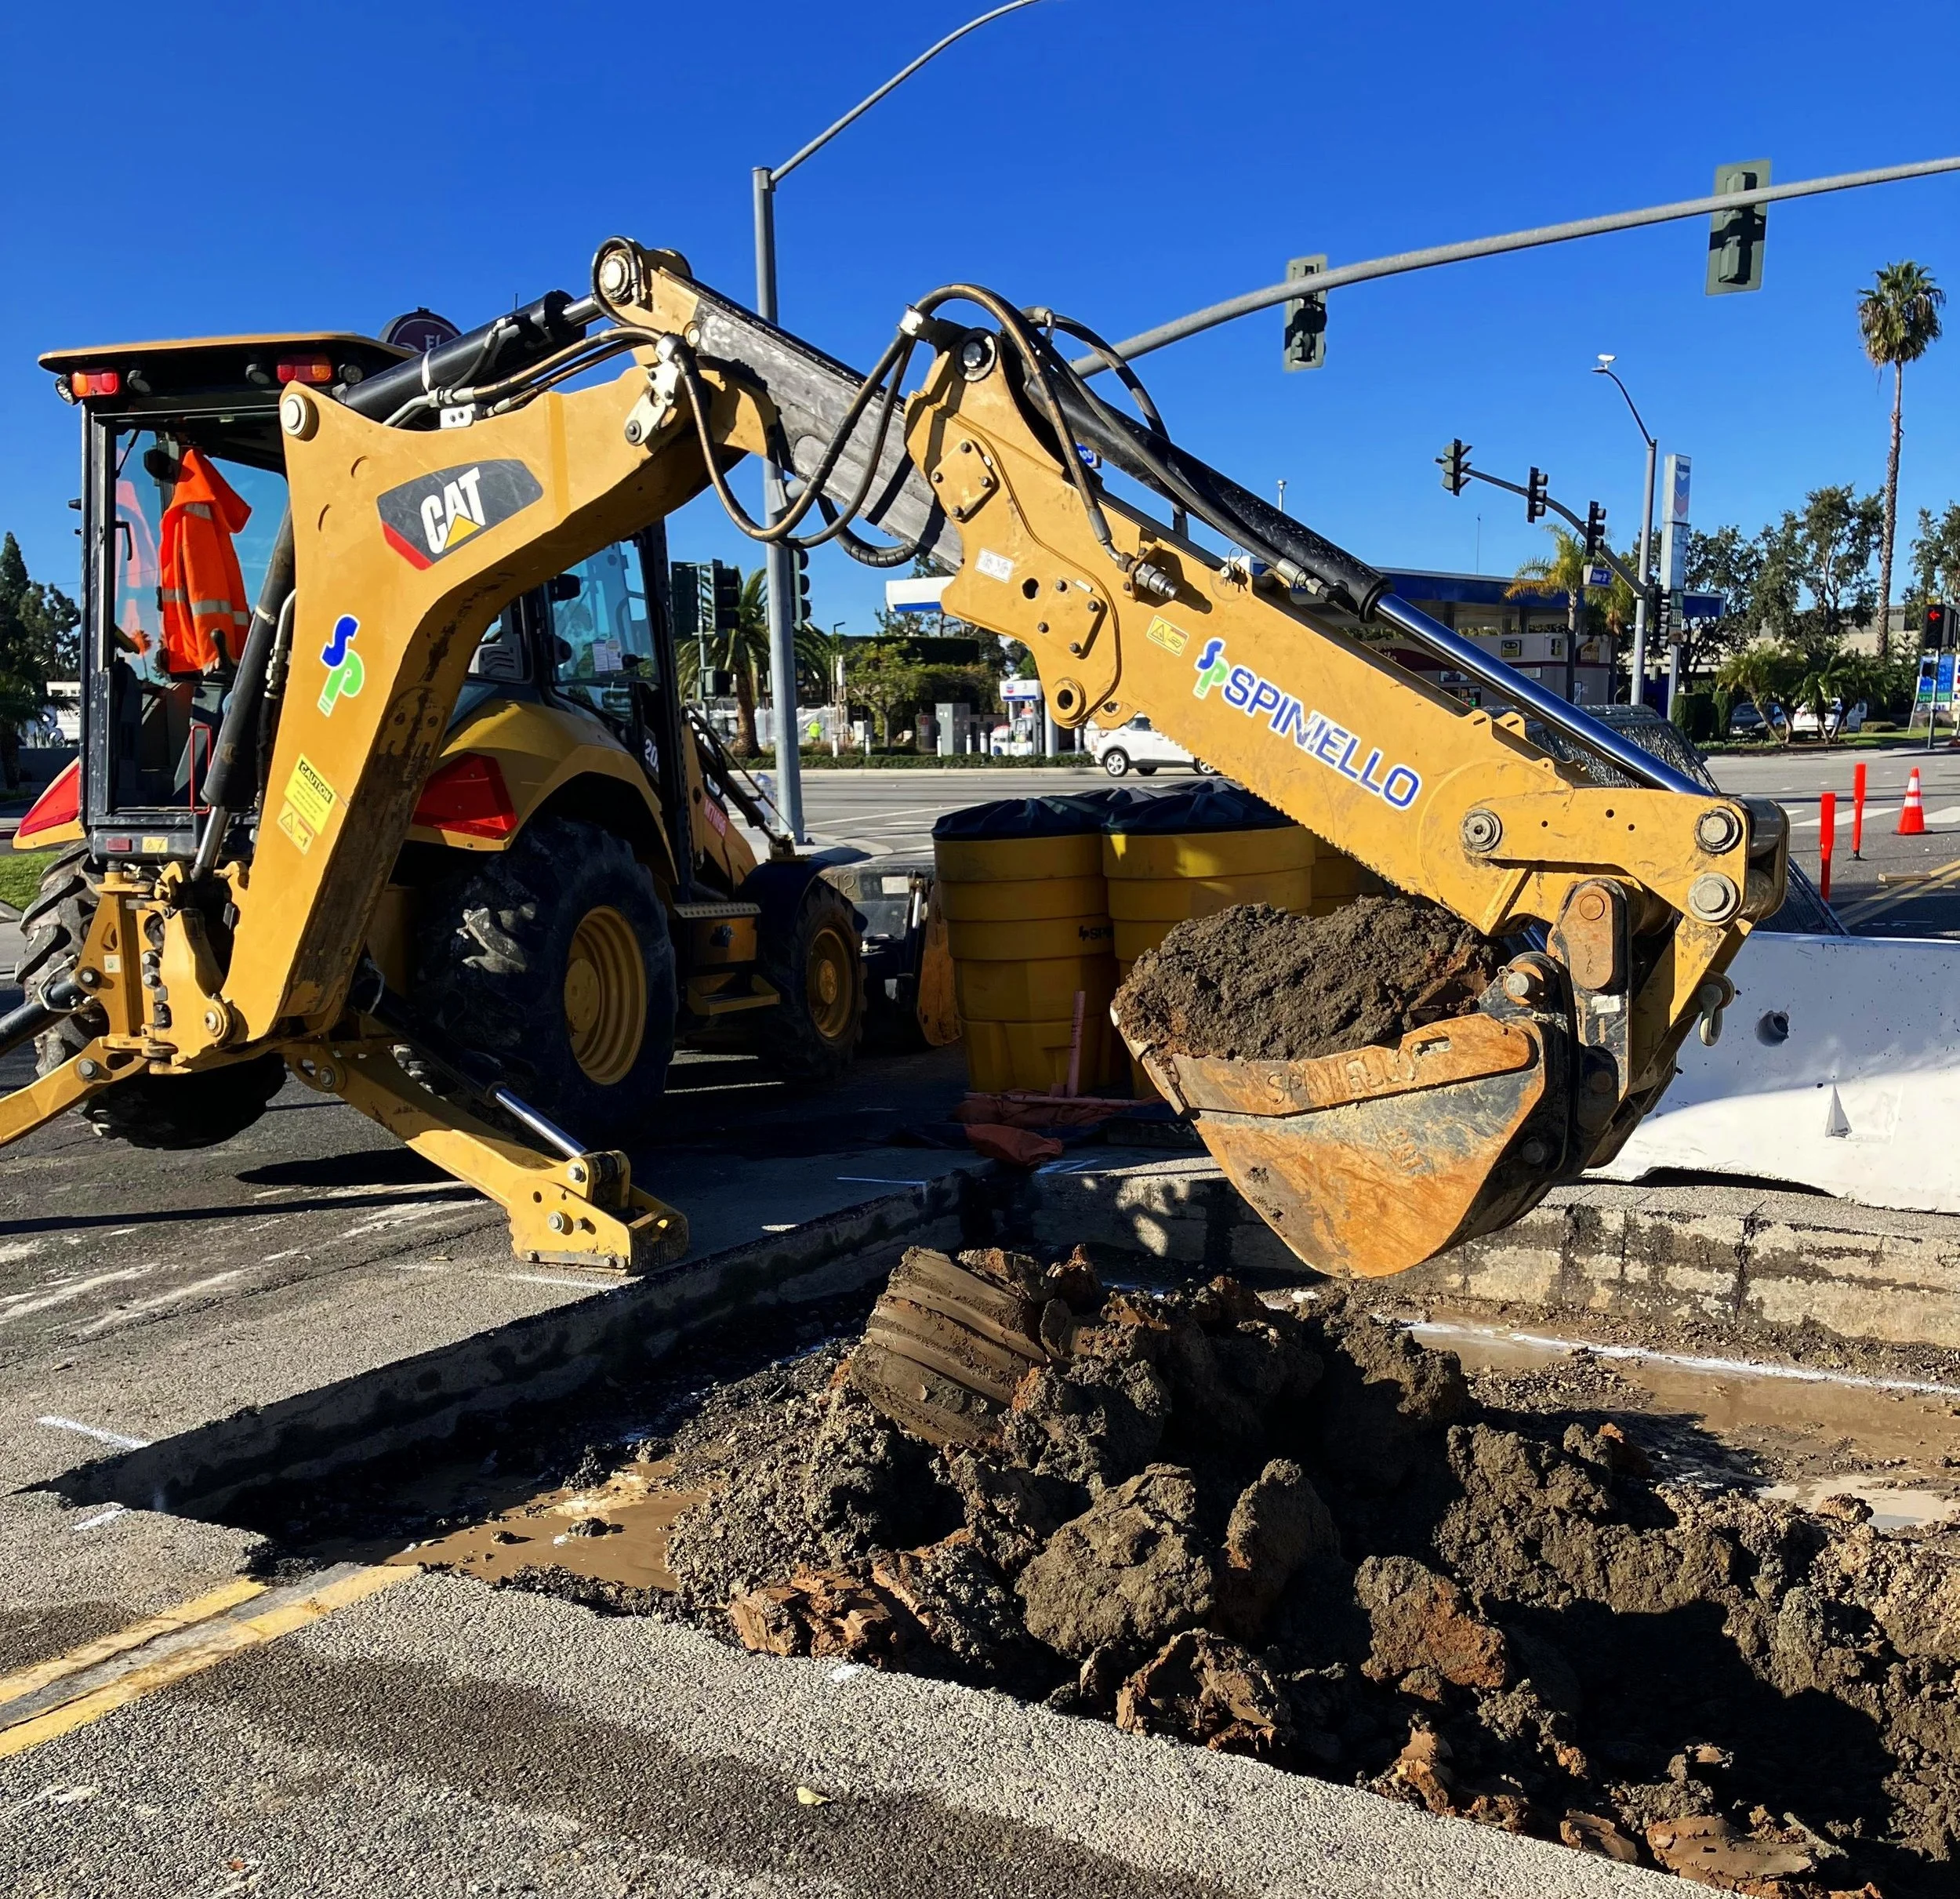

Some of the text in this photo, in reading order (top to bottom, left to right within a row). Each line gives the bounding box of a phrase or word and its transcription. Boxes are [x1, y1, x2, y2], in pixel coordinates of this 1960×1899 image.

[420, 467, 485, 554] CAT
[1221, 665, 1421, 809] SPINELLO
[300, 763, 332, 801] CAUTION
